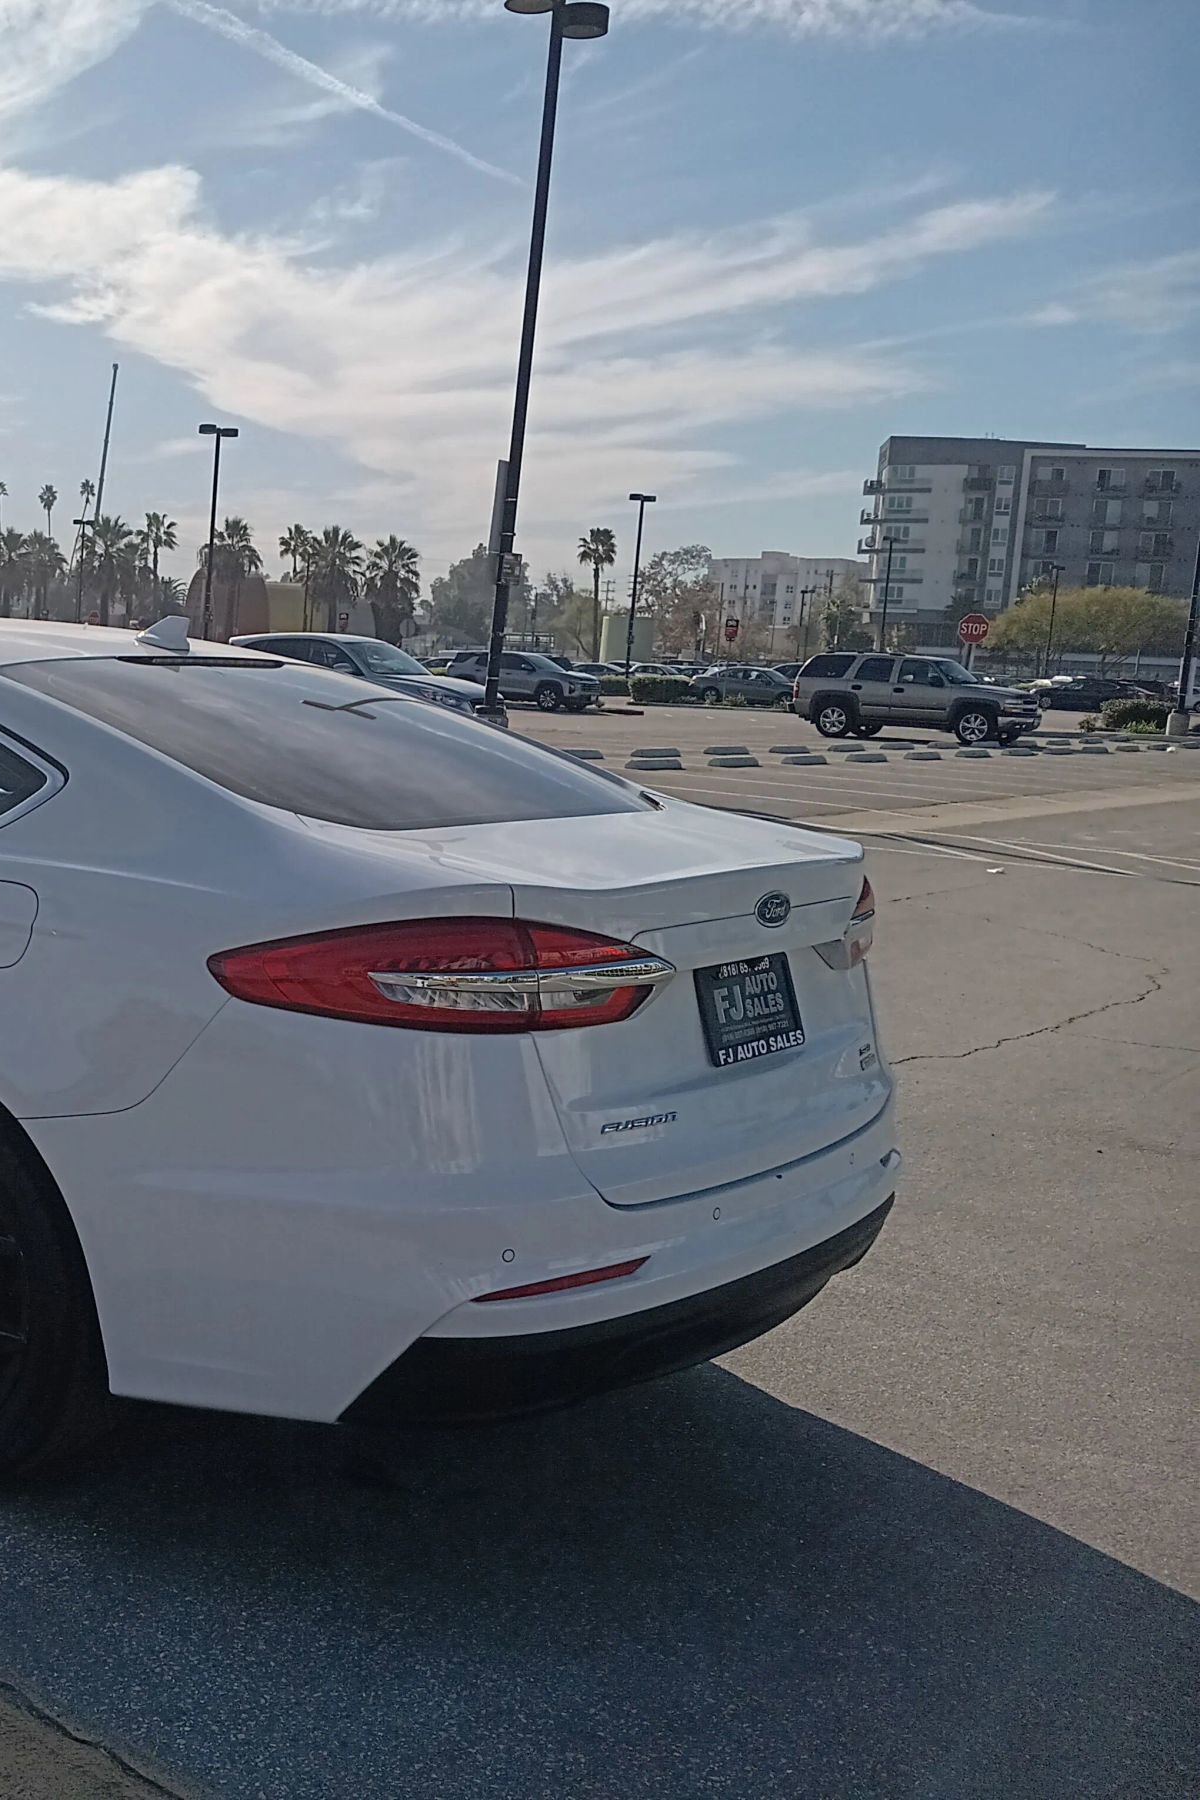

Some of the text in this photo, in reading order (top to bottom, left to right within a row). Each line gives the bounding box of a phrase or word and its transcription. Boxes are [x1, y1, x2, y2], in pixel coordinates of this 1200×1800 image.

[960, 622, 988, 635] STOP
[745, 971, 778, 996] AUTO
[713, 984, 744, 1024] FJ
[745, 992, 785, 1018] SALES
[718, 1047, 734, 1065] FJ
[737, 1039, 768, 1061] AUTO
[768, 1029, 804, 1052] SALES
